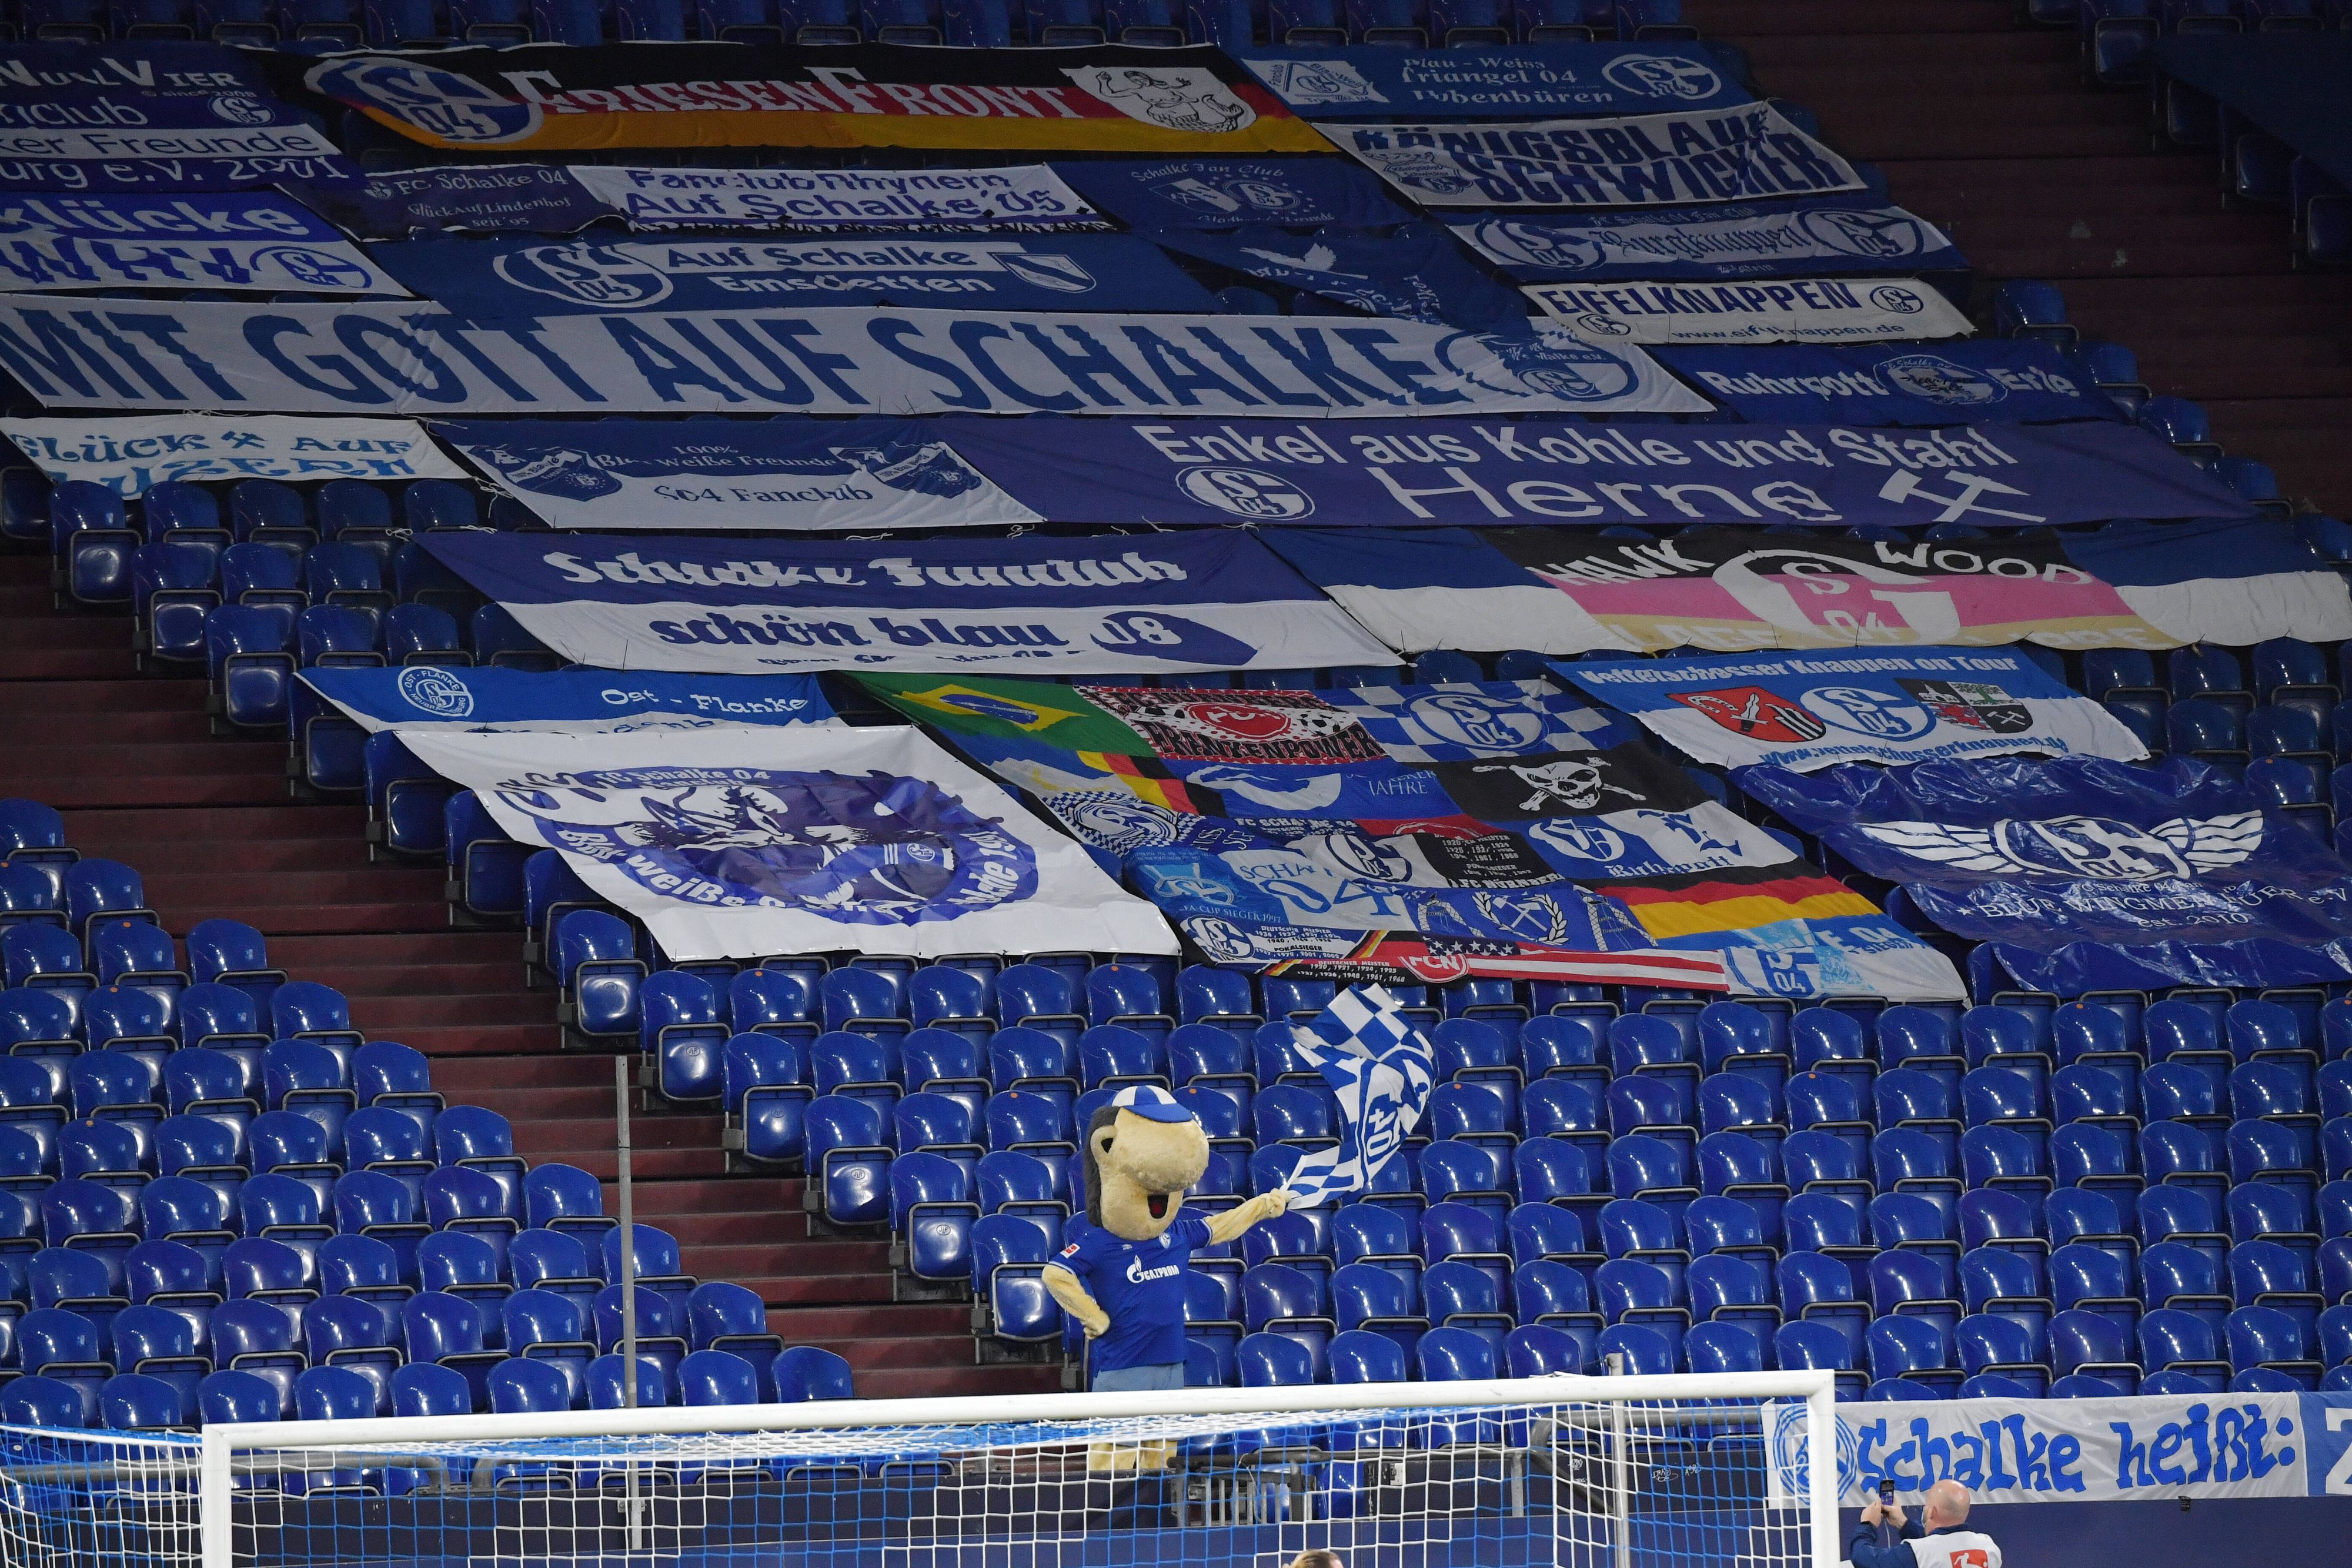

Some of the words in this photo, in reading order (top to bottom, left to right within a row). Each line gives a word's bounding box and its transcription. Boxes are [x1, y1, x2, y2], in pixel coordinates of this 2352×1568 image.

[1478, 58, 1545, 69] Weiss
[1539, 69, 1578, 83] 04
[81, 132, 319, 155] Freunde
[103, 159, 204, 182] e.V.
[394, 180, 432, 195] FC
[435, 172, 533, 189] Schalke
[537, 169, 570, 186] 04
[624, 192, 725, 219] Auf
[744, 193, 980, 219] Schalke
[668, 248, 747, 269] Auf
[766, 246, 977, 269] Schalke
[718, 273, 996, 294] Emsdetten
[1539, 282, 1861, 315] EIFELKNAPPEN
[0, 308, 247, 400] MIT
[242, 314, 607, 404] GOTT
[599, 316, 871, 405] AUF
[866, 317, 1474, 409] SCHALKE
[1696, 370, 1890, 402] Ruhrpott
[671, 445, 739, 454] 100%
[1131, 425, 1349, 465] Enkel
[1350, 434, 1482, 464] aus
[1471, 426, 1692, 466] Kohle
[1693, 429, 1835, 469] und
[1827, 427, 2019, 469] Stahl
[737, 456, 836, 467] Freunde
[49, 457, 417, 500] UZERN
[734, 485, 874, 504] Fanclub
[1364, 466, 1843, 521] Herne
[1527, 539, 1717, 586] HAWK
[1873, 540, 2096, 585] WOOD
[650, 612, 871, 647] schön
[869, 617, 1070, 647] blau
[1786, 658, 1913, 677] Knappen
[1915, 660, 1949, 674] on
[1950, 656, 2020, 671] Tour
[420, 670, 460, 691] FLANKE
[601, 688, 659, 705] Ost
[690, 694, 809, 714] Flanke
[626, 768, 728, 781] Schalke
[733, 768, 771, 780] 04
[1603, 855, 1734, 878] Ruhrpott
[1976, 898, 2063, 918] BLUE
[2067, 894, 2219, 913] WINGMEN
[1262, 913, 1281, 924] 1997
[2189, 912, 2249, 925] 2010
[1773, 971, 1807, 993] 04
[1143, 1265, 1180, 1281] GAZPROM
[1857, 1413, 2087, 1493] Schalke
[2109, 1402, 2296, 1489] heißt:
